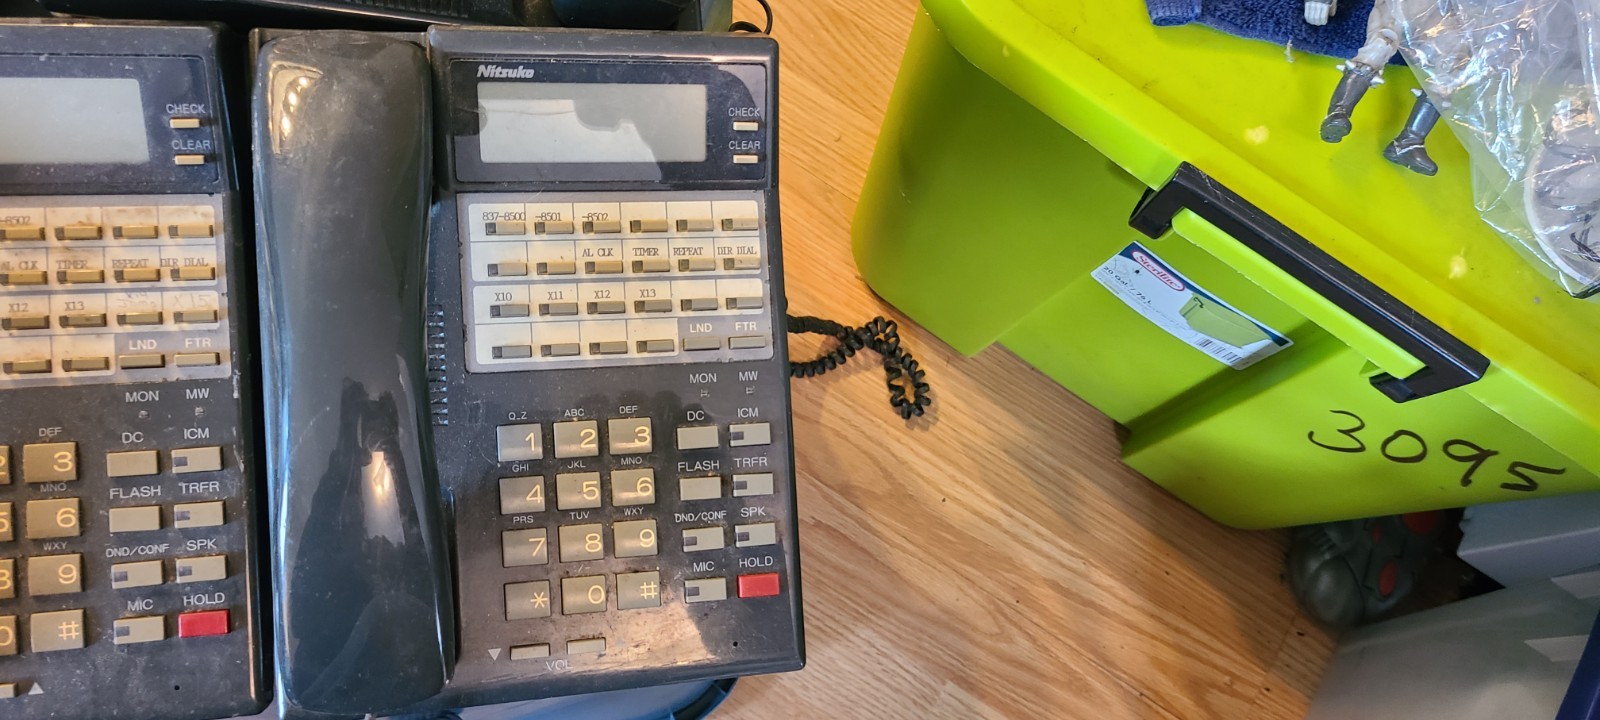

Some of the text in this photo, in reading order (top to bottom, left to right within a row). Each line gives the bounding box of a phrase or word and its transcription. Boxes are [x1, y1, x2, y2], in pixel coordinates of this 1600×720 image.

[477, 64, 535, 79] Nitsuko
[166, 104, 206, 114] CHECK
[728, 107, 760, 118] CHECK
[171, 140, 211, 150] CLEAR
[729, 140, 760, 151] CLEAR
[482, 211, 526, 221] 837-8500
[582, 248, 594, 257] AL
[632, 247, 659, 257] TIMER
[673, 246, 704, 256] REPEAT
[717, 245, 757, 255] DIR DIAL
[56, 259, 88, 269] TIMER
[112, 258, 149, 269] REPEAT
[160, 257, 209, 268] DIR DIAL
[494, 292, 513, 302] X10
[547, 291, 564, 300] X11
[594, 289, 611, 299] X12
[639, 289, 657, 298] X13
[8, 303, 29, 313] X12
[64, 301, 85, 311] X13
[689, 322, 713, 333] LND
[735, 321, 758, 332] FTR
[129, 339, 157, 351] LND
[185, 337, 212, 349] FTR
[689, 373, 717, 384] MON
[738, 371, 758, 381] MW
[125, 390, 160, 403] MON
[186, 388, 210, 400] MW
[564, 408, 585, 418] ABC
[619, 405, 638, 414] DEF
[737, 407, 759, 418] ICM
[687, 410, 705, 421] DC
[38, 426, 63, 437] DEF
[183, 428, 210, 440] ICM
[634, 426, 651, 446] 3
[121, 432, 145, 444] DC
[525, 432, 536, 452] 1
[580, 428, 597, 449] 2
[1308, 410, 1566, 491] 3095
[53, 451, 73, 472] 3
[567, 460, 586, 469] JKL
[620, 456, 643, 466] MNO
[677, 460, 720, 472] FLASH
[733, 456, 768, 468] TRFR
[512, 464, 529, 473] GHI
[40, 482, 67, 493] MNO
[181, 481, 220, 495] TRFR
[582, 481, 599, 501] 5
[636, 477, 653, 497] 6
[109, 486, 162, 500] FLASH
[526, 484, 543, 504] 4
[569, 511, 590, 520] TUV
[623, 507, 644, 516] WXY
[674, 510, 727, 523] DND/CONF
[740, 506, 766, 518] SPK
[56, 507, 77, 529] 6
[513, 515, 534, 524] PRS
[585, 533, 602, 553] 8
[639, 528, 655, 548] 9
[43, 541, 68, 551] WXY
[186, 538, 217, 551] SPK
[529, 537, 545, 557] 7
[106, 543, 170, 558] DND/CONF
[693, 561, 715, 573] MIC
[739, 556, 774, 568] HOLD
[58, 563, 77, 584] 9
[588, 584, 605, 604] 0
[640, 581, 658, 600] #
[183, 592, 225, 607] HOLD
[127, 599, 154, 612] MIC
[58, 620, 80, 640] #
[545, 660, 574, 671] VOL
